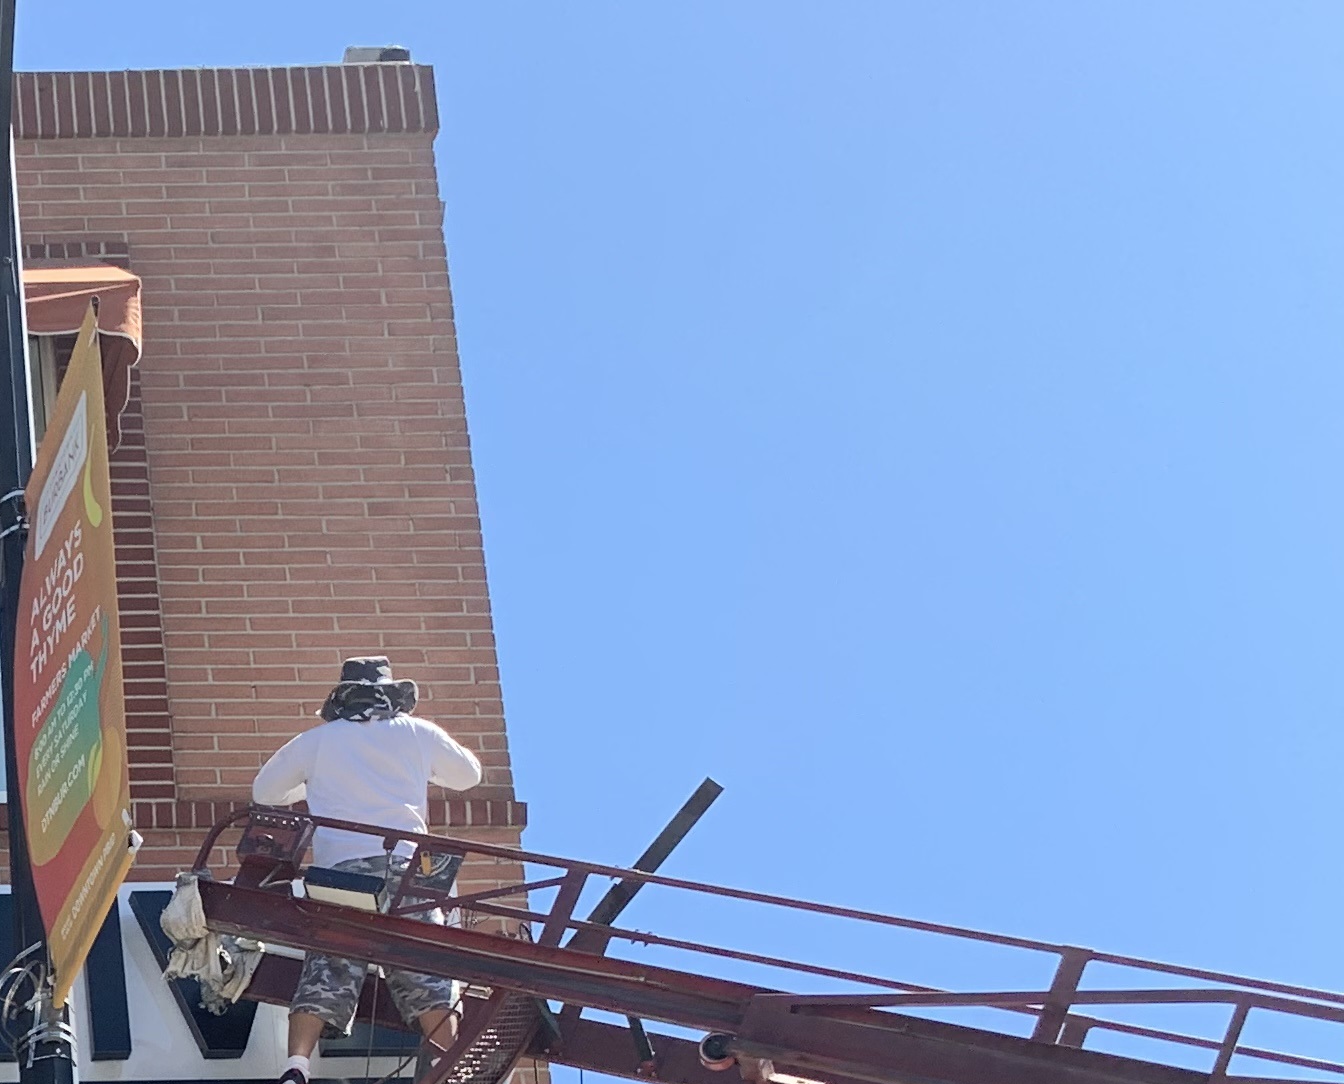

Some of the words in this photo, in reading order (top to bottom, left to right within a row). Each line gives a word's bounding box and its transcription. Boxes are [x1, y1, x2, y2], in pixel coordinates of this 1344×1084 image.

[30, 519, 83, 626] ALWAYS
[30, 627, 40, 657] A
[42, 551, 85, 632] GOOD
[30, 594, 77, 684] THYME
[31, 661, 67, 729] FARMERS
[68, 604, 102, 669] MARKET
[35, 747, 55, 781] EVERY
[53, 690, 88, 751] SATURDAY
[62, 723, 81, 757] SHINE
[40, 754, 87, 834] DTNBUR.COM
